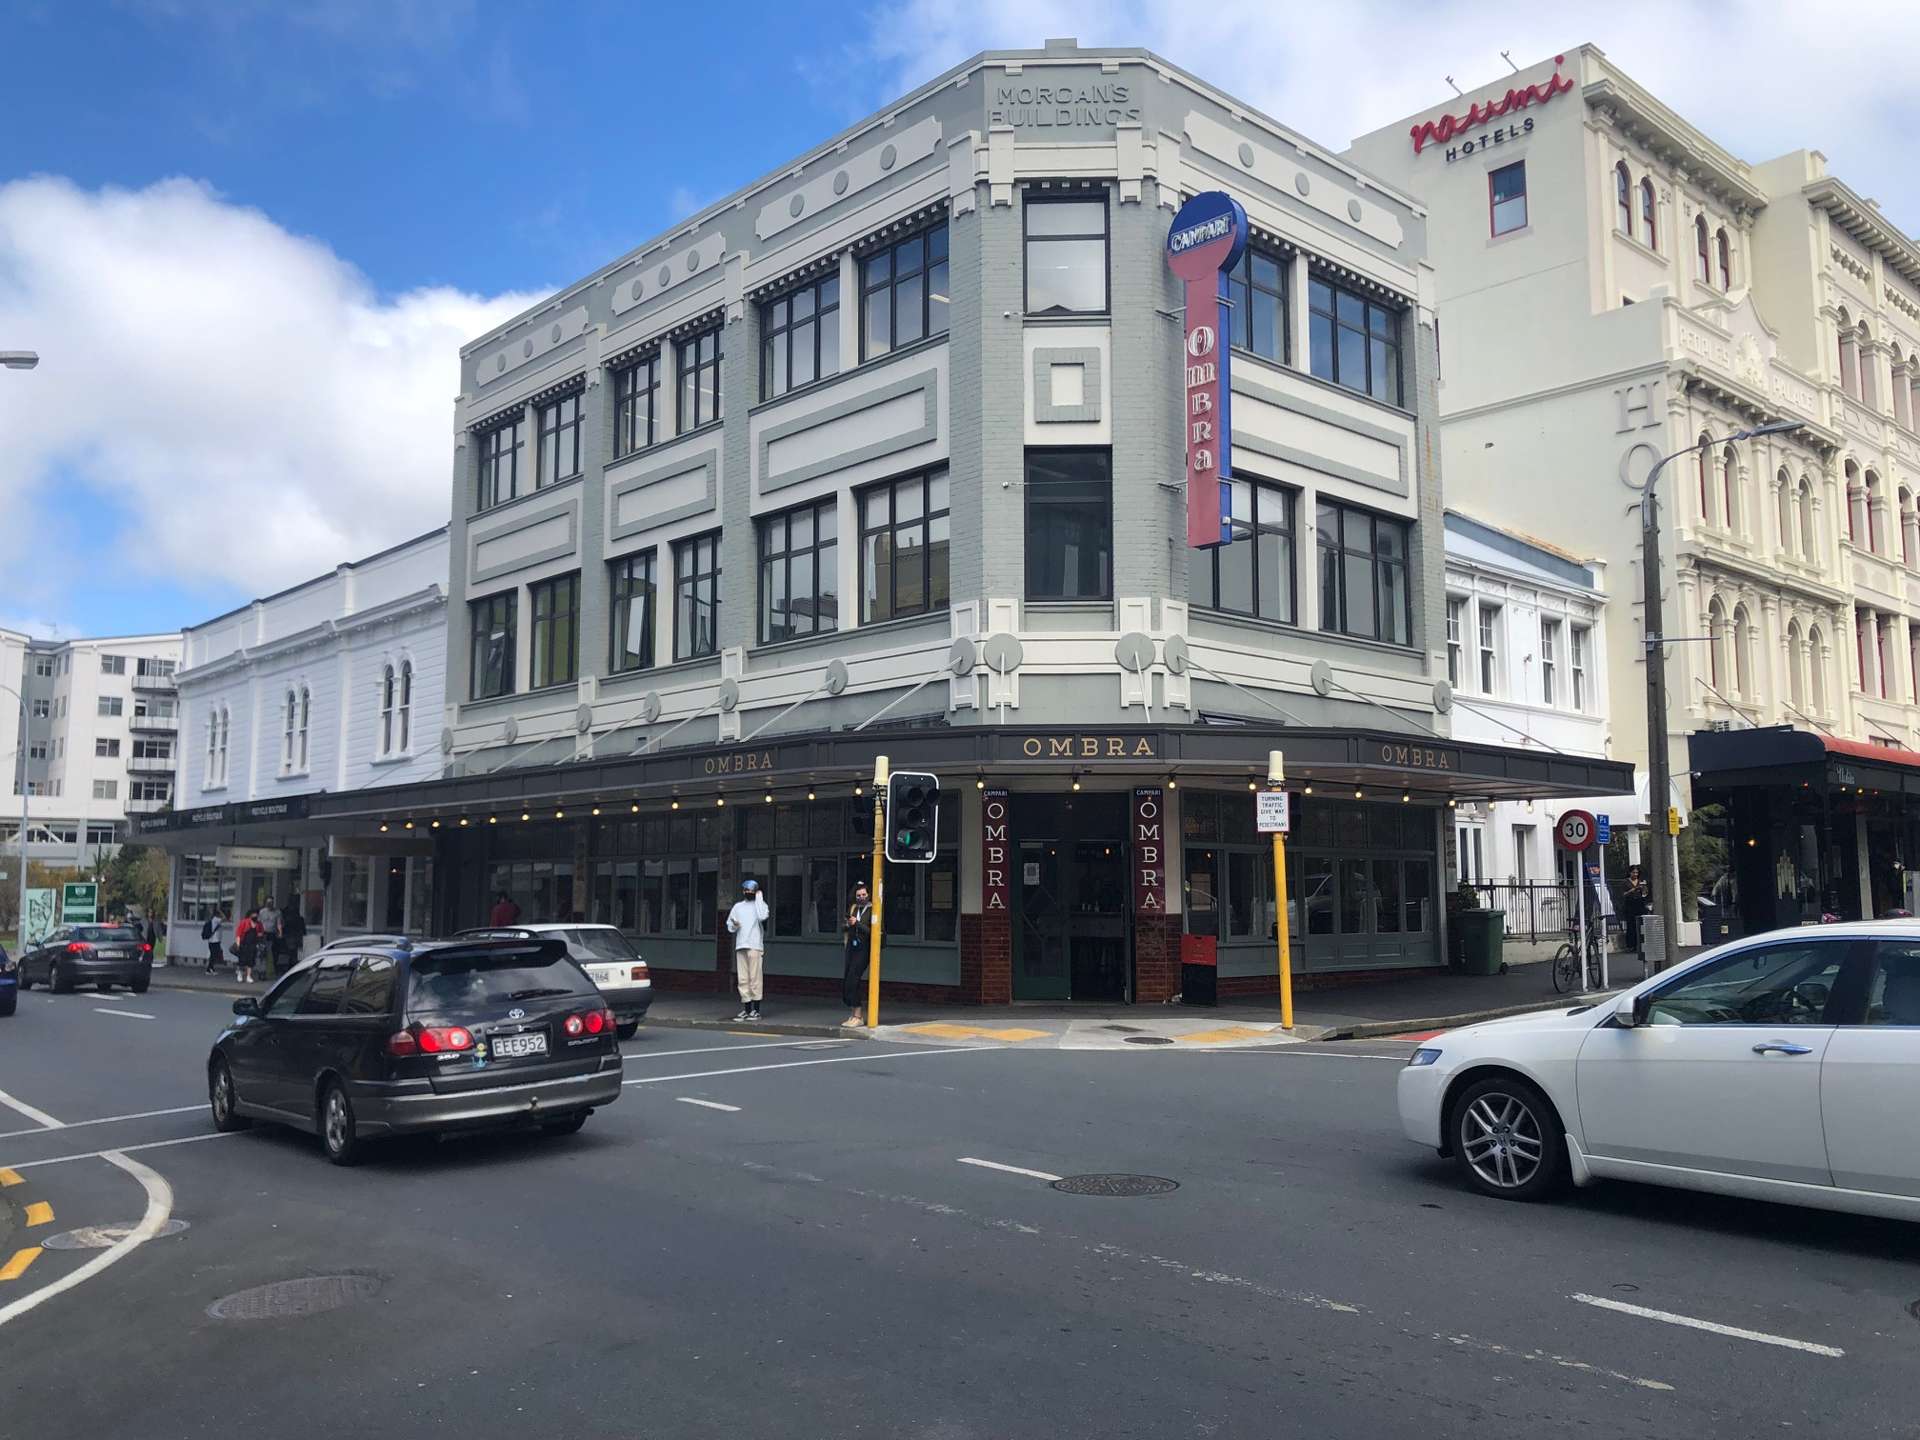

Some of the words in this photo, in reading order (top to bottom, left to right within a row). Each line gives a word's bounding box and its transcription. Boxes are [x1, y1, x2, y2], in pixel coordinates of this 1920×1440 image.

[987, 108, 1142, 127] BUILDINGS
[1446, 117, 1535, 162] HOTELS
[1171, 216, 1229, 252] CAMPARI
[1023, 737, 1154, 757] OMBRA
[1382, 745, 1449, 768] OMBRA
[705, 752, 773, 774] OMBRA
[1565, 822, 1586, 838] 30
[985, 803, 1008, 909] OMBRA
[1138, 802, 1161, 909] OMBRA
[494, 1036, 546, 1056] EEE952
